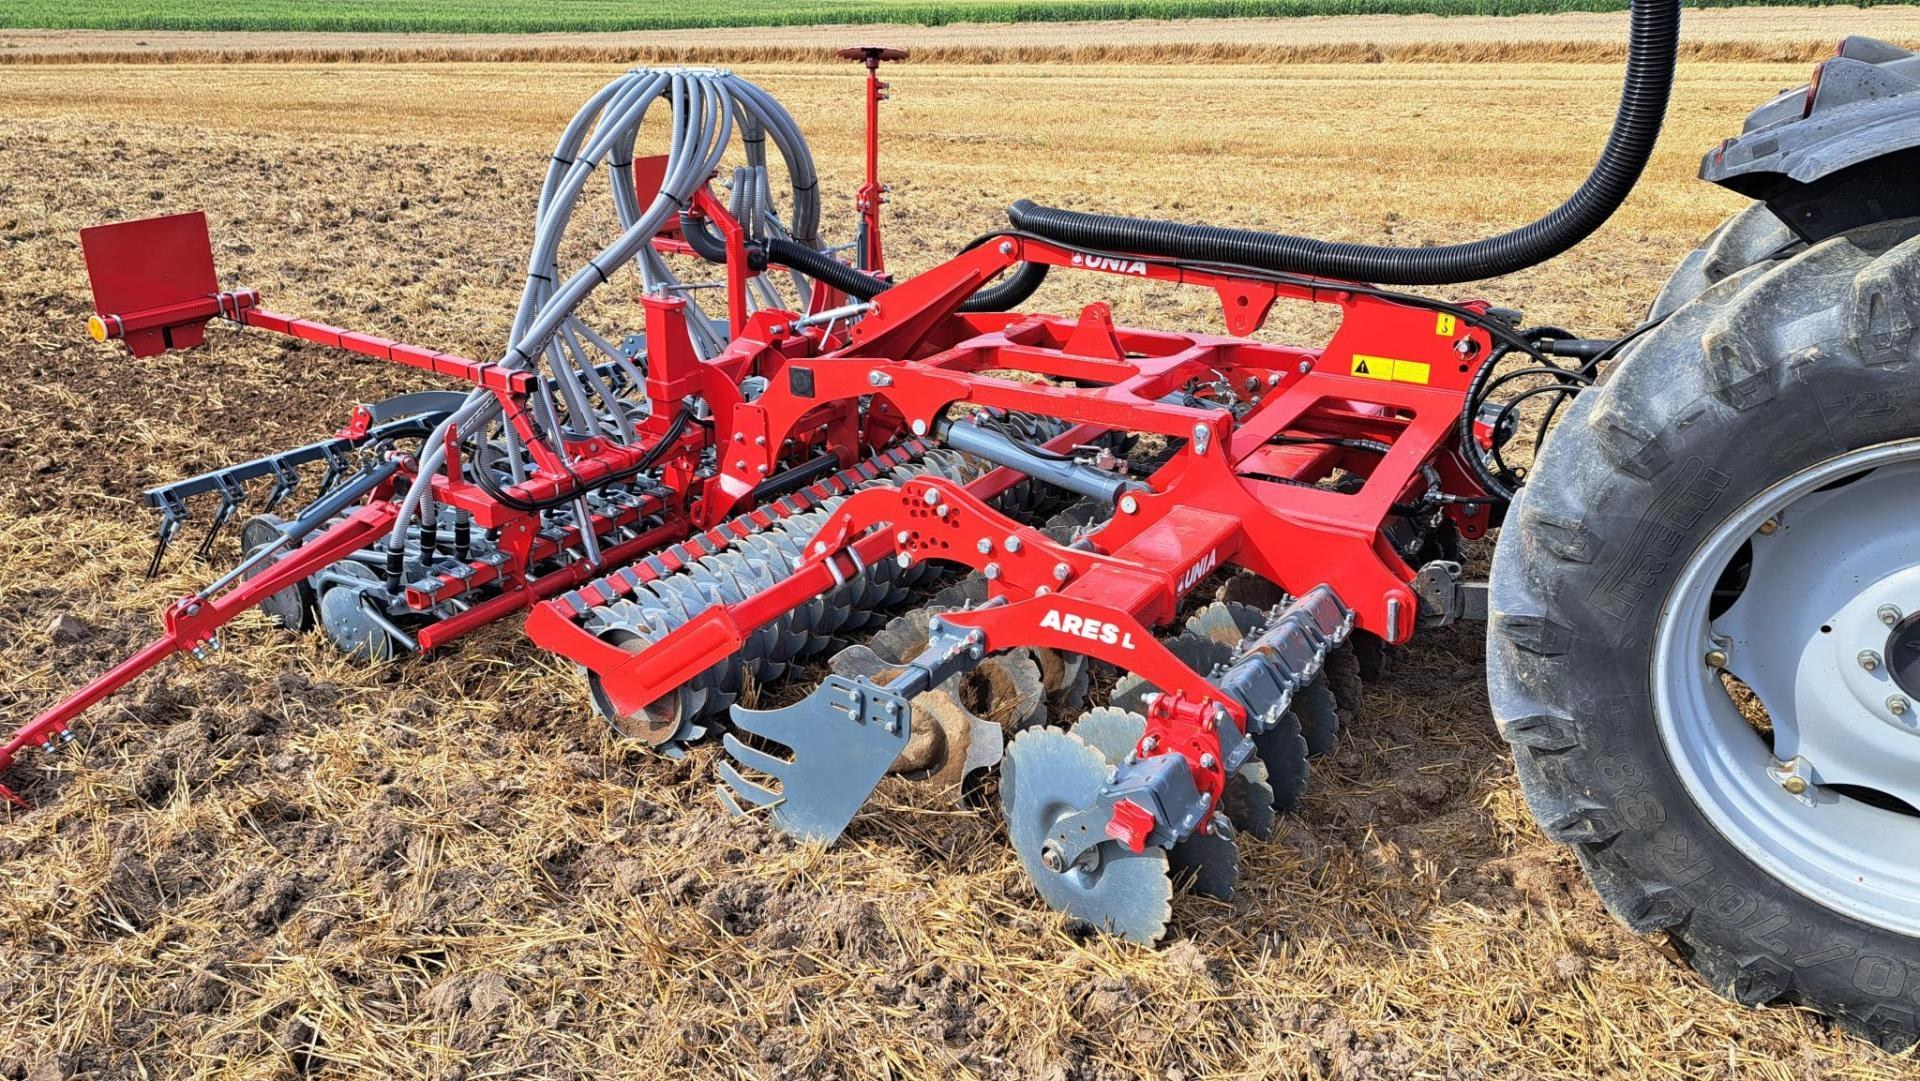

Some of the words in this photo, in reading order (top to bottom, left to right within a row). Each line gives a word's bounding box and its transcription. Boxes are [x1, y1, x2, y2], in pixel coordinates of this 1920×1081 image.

[1085, 254, 1147, 275] UNIA
[1584, 455, 1731, 622] PIRELLI
[1184, 548, 1216, 589] UNIA
[1040, 609, 1120, 645] ARES
[1121, 631, 1136, 650] L
